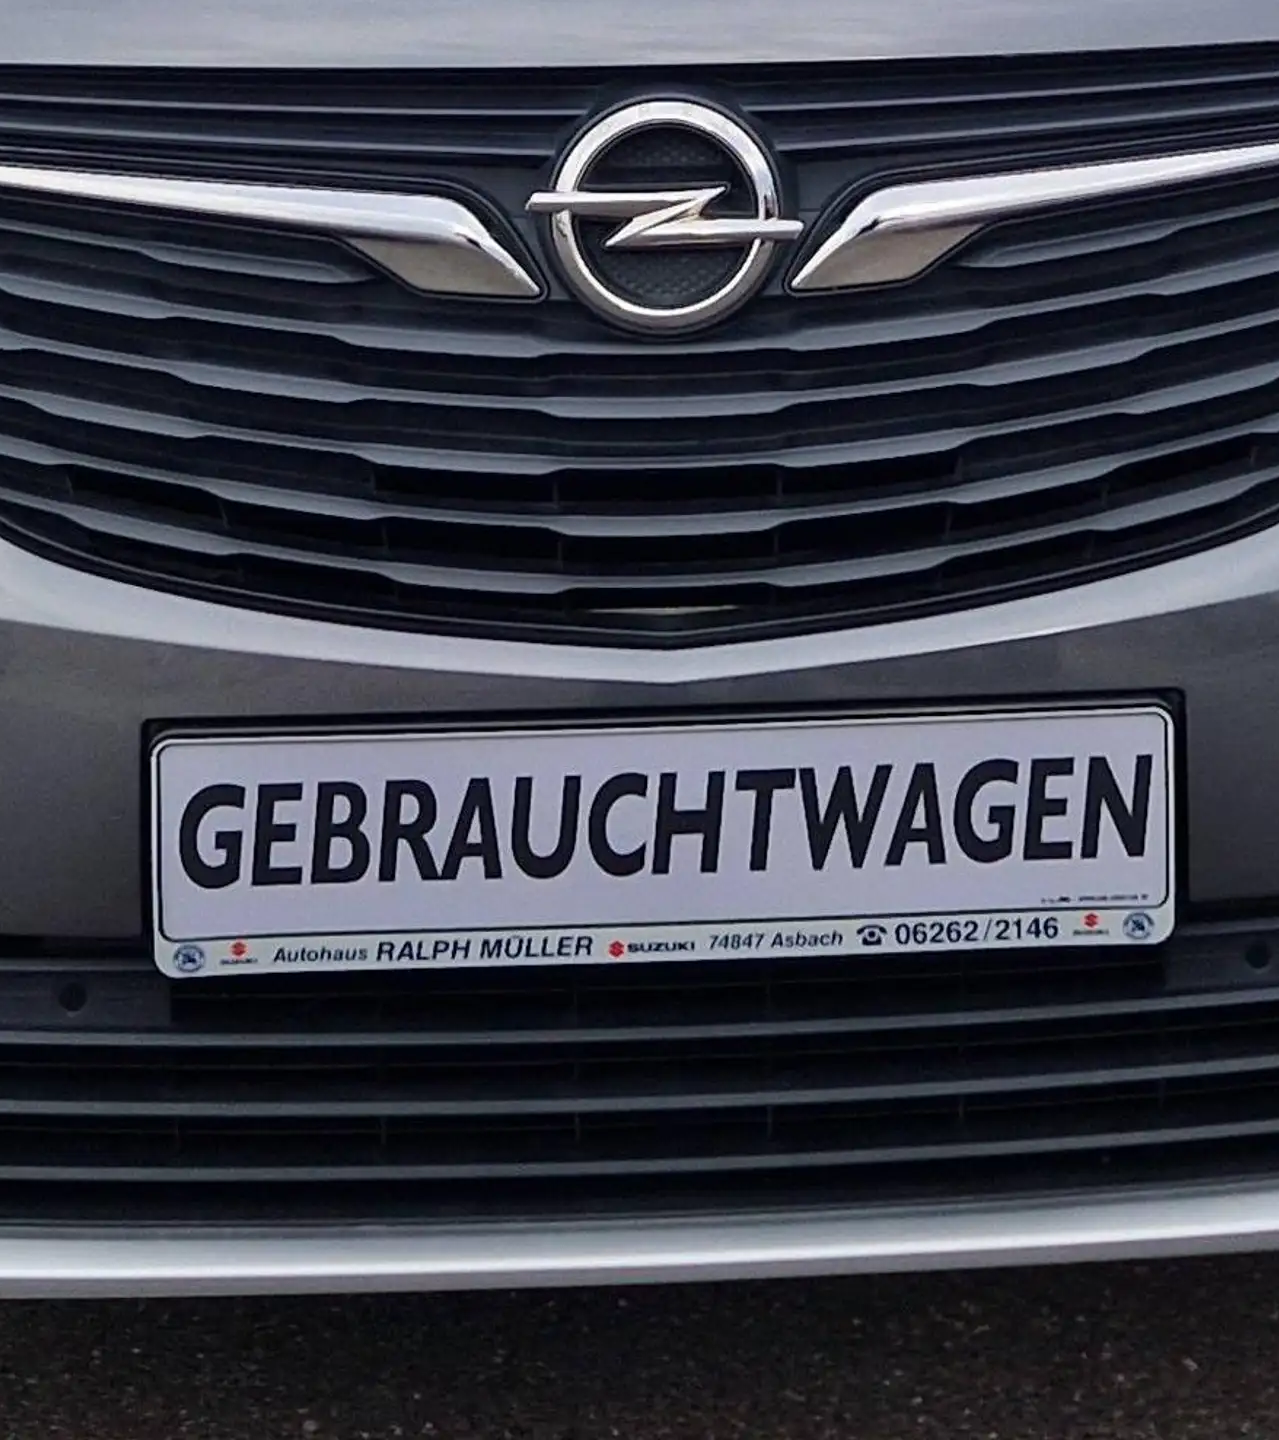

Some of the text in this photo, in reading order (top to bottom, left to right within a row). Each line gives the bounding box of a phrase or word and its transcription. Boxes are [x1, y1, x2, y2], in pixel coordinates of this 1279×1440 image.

[179, 754, 1153, 889] GEBRAUCHTWAGEN
[273, 946, 369, 963] Autohaus
[375, 939, 472, 962] RALPH
[479, 935, 594, 959] MÜLLER
[627, 941, 696, 953] SUZUKI
[709, 933, 765, 951] 74847
[770, 930, 844, 948] Asbach
[894, 916, 1059, 945] 06262/2146
